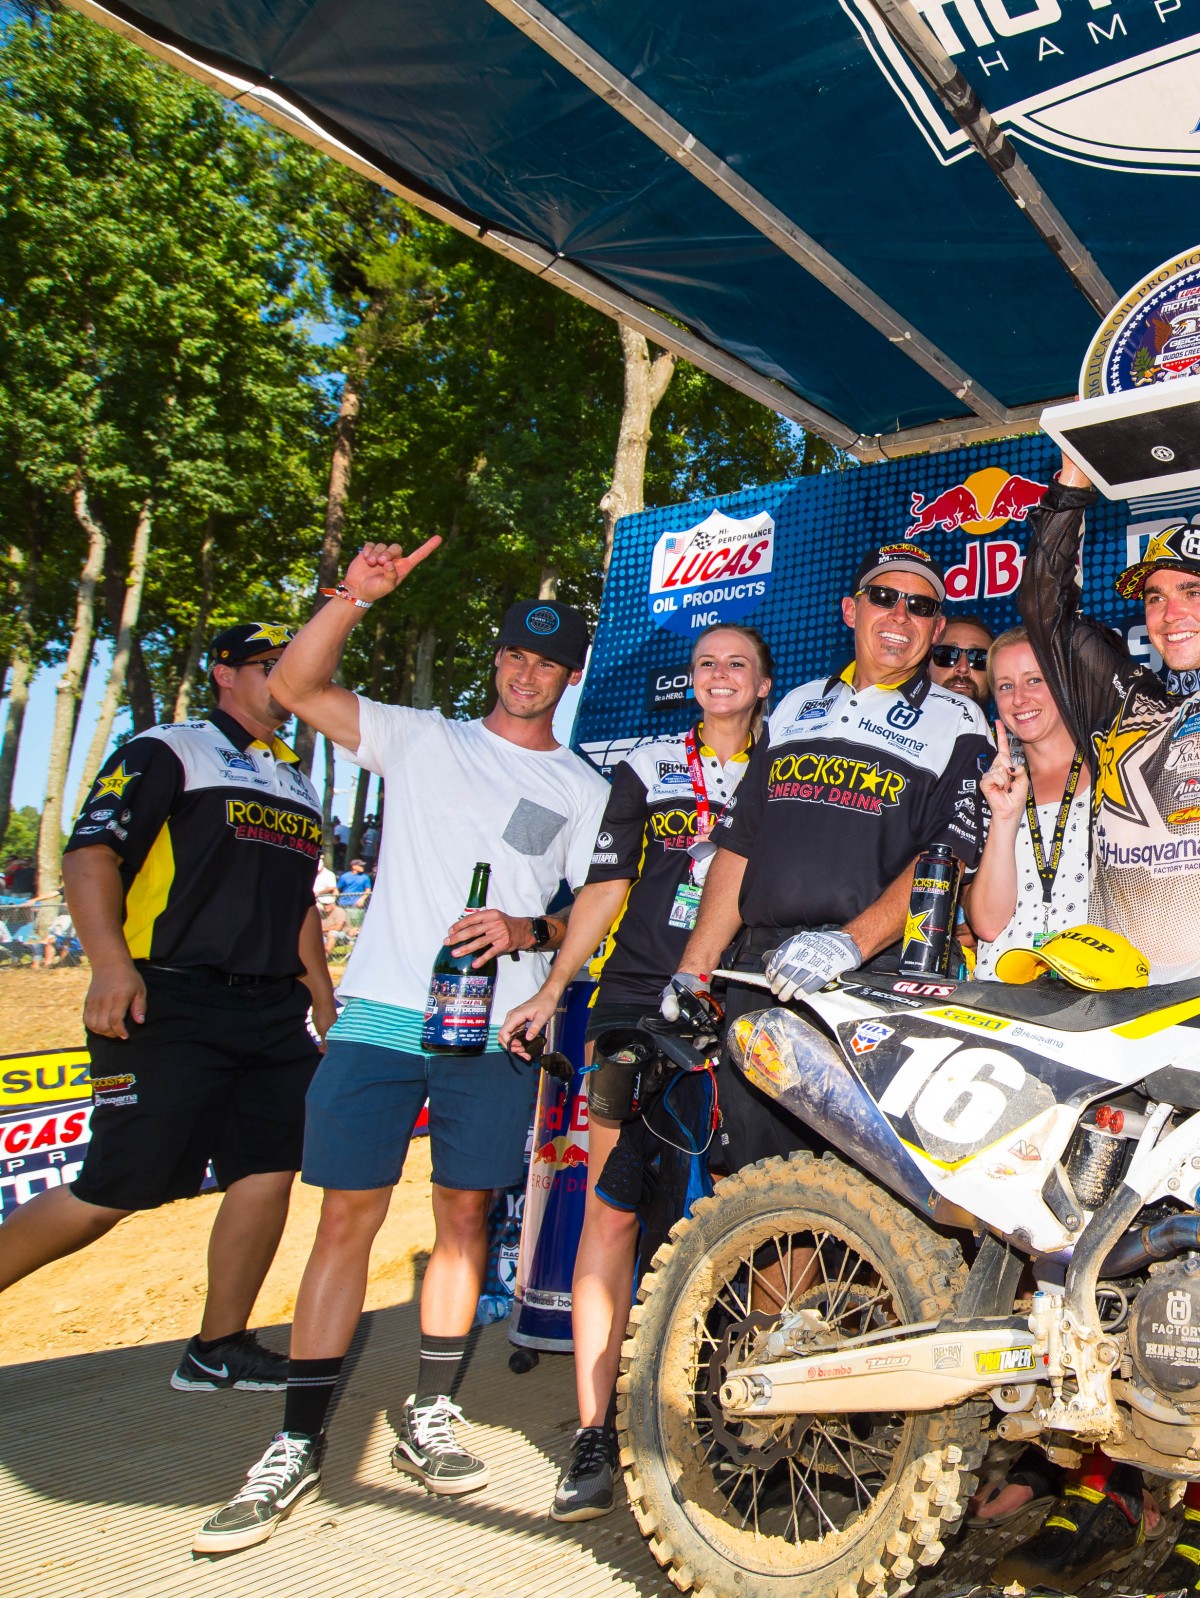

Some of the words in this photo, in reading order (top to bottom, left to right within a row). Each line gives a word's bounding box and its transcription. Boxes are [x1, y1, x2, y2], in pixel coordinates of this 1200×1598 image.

[1093, 329, 1116, 371] LUCAS
[1112, 296, 1138, 325] OIL
[1138, 270, 1170, 301] PRO
[717, 527, 773, 545] PERFORMANCE
[661, 540, 770, 589] LUCAS
[652, 597, 679, 614] OIL
[682, 581, 766, 609] PRODUCTS
[690, 611, 722, 628] INC.
[857, 716, 925, 752] Husqvarna
[768, 753, 905, 803] ROCKSTAR
[769, 784, 824, 800] ENERGY
[828, 786, 883, 812] DRINK
[228, 801, 323, 845] ROCKSTA
[237, 824, 284, 845] ENERGY
[1153, 863, 1184, 875] FACTORY
[871, 990, 924, 1008] SCOSCHE
[892, 981, 955, 996] GUTS
[1022, 1030, 1064, 1049] Husqvarna
[876, 1036, 1026, 1144] 16
[0, 1112, 87, 1154] CAS
[817, 1365, 852, 1378] brembo
